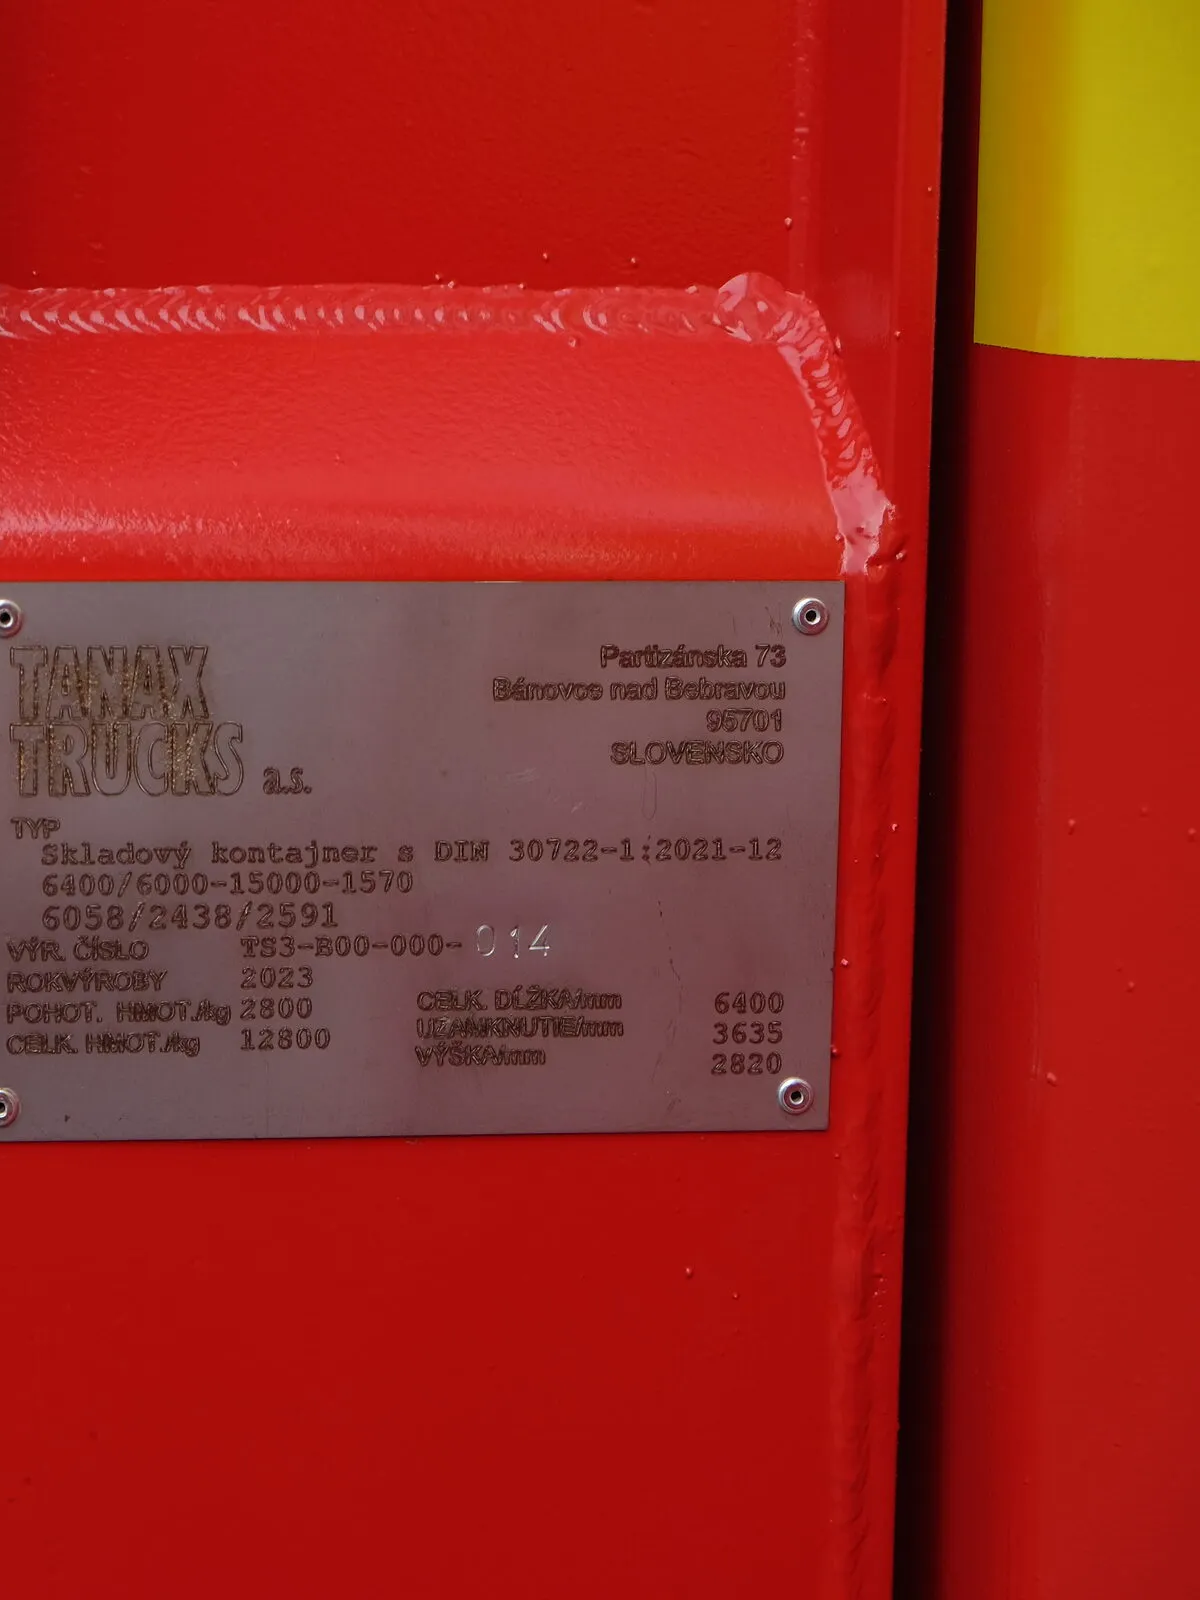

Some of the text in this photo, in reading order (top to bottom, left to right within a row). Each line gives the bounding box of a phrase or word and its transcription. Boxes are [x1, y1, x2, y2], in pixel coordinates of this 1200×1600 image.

[600, 644, 786, 668] Partizánska 73
[10, 645, 209, 721] TANAX
[492, 676, 786, 701] Bánovce nad Bebravou
[706, 708, 783, 732] 95701
[10, 722, 312, 796] TRUCKS a.s.
[610, 740, 784, 765] SLOVENSKO
[10, 817, 60, 839] TYP
[41, 837, 783, 868] Skladový kontajner s DIN 30722-1:2021-12
[42, 870, 413, 897] 6400/6000-15000-1570
[42, 901, 339, 932] 6058/2438/2591
[7, 936, 66, 962] VÝR.
[73, 935, 150, 961] ČÍSLO
[240, 966, 314, 989] 2023
[7, 1001, 102, 1023] POHOT.
[240, 997, 313, 1020] 2800
[416, 989, 487, 1011] CELK.
[714, 991, 784, 1015] 6400
[7, 1033, 78, 1055] CELK.
[240, 1028, 331, 1050] 12800
[712, 1021, 783, 1045] 3635
[414, 1041, 783, 1076] VÝŠKA/mm 2820
